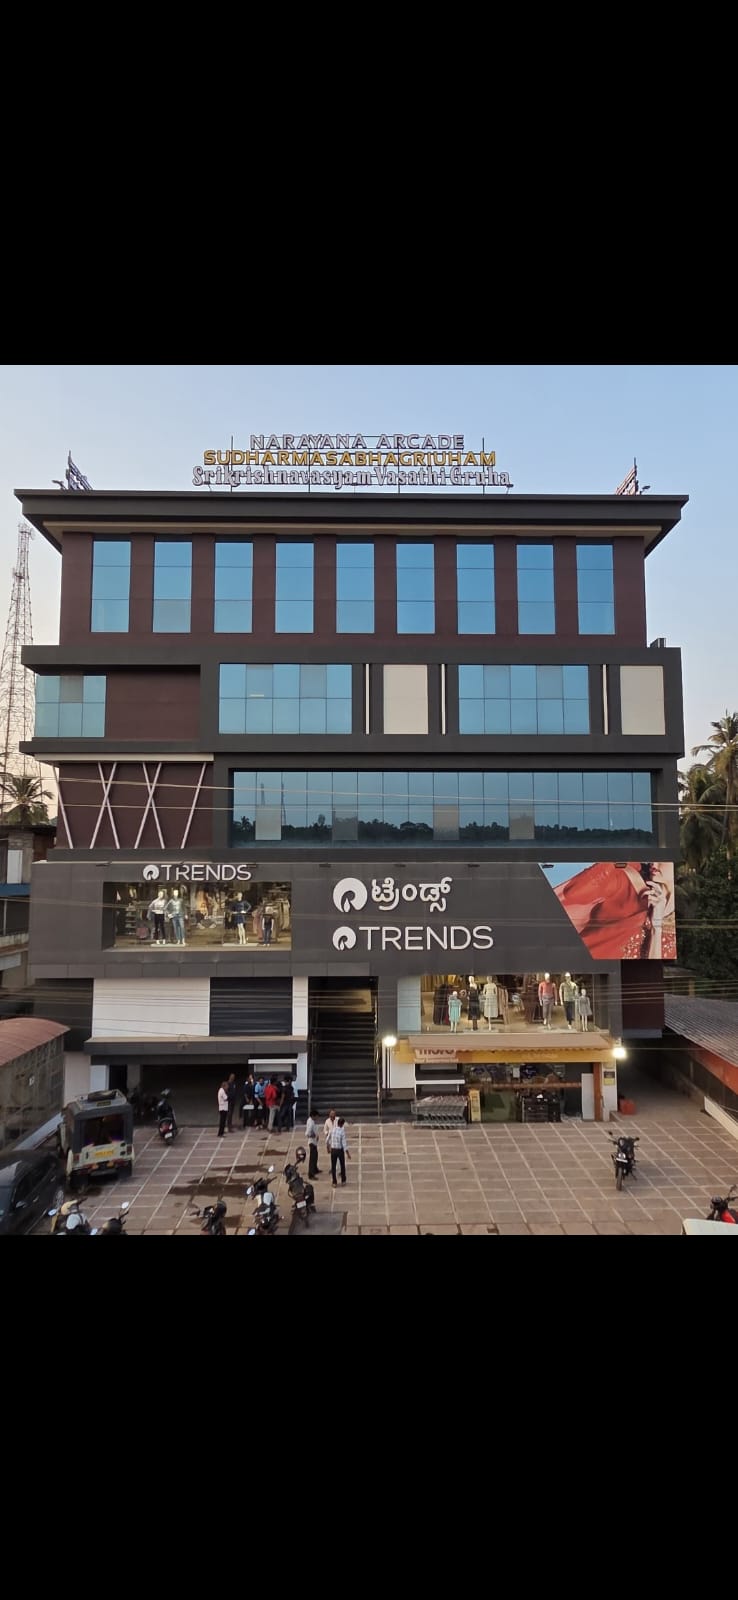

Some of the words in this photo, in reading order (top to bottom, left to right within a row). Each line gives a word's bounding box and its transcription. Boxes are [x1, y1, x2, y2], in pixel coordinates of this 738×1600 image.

[250, 434, 367, 450] NARAYANA
[376, 434, 464, 450] ARCADE
[204, 450, 496, 467] SUDHARMASABHAGRIUHAM
[160, 864, 252, 881] TRENDS
[371, 877, 453, 912] ಟ್ರೆಂಡ್ಸ್
[358, 925, 494, 951] TRENDS
